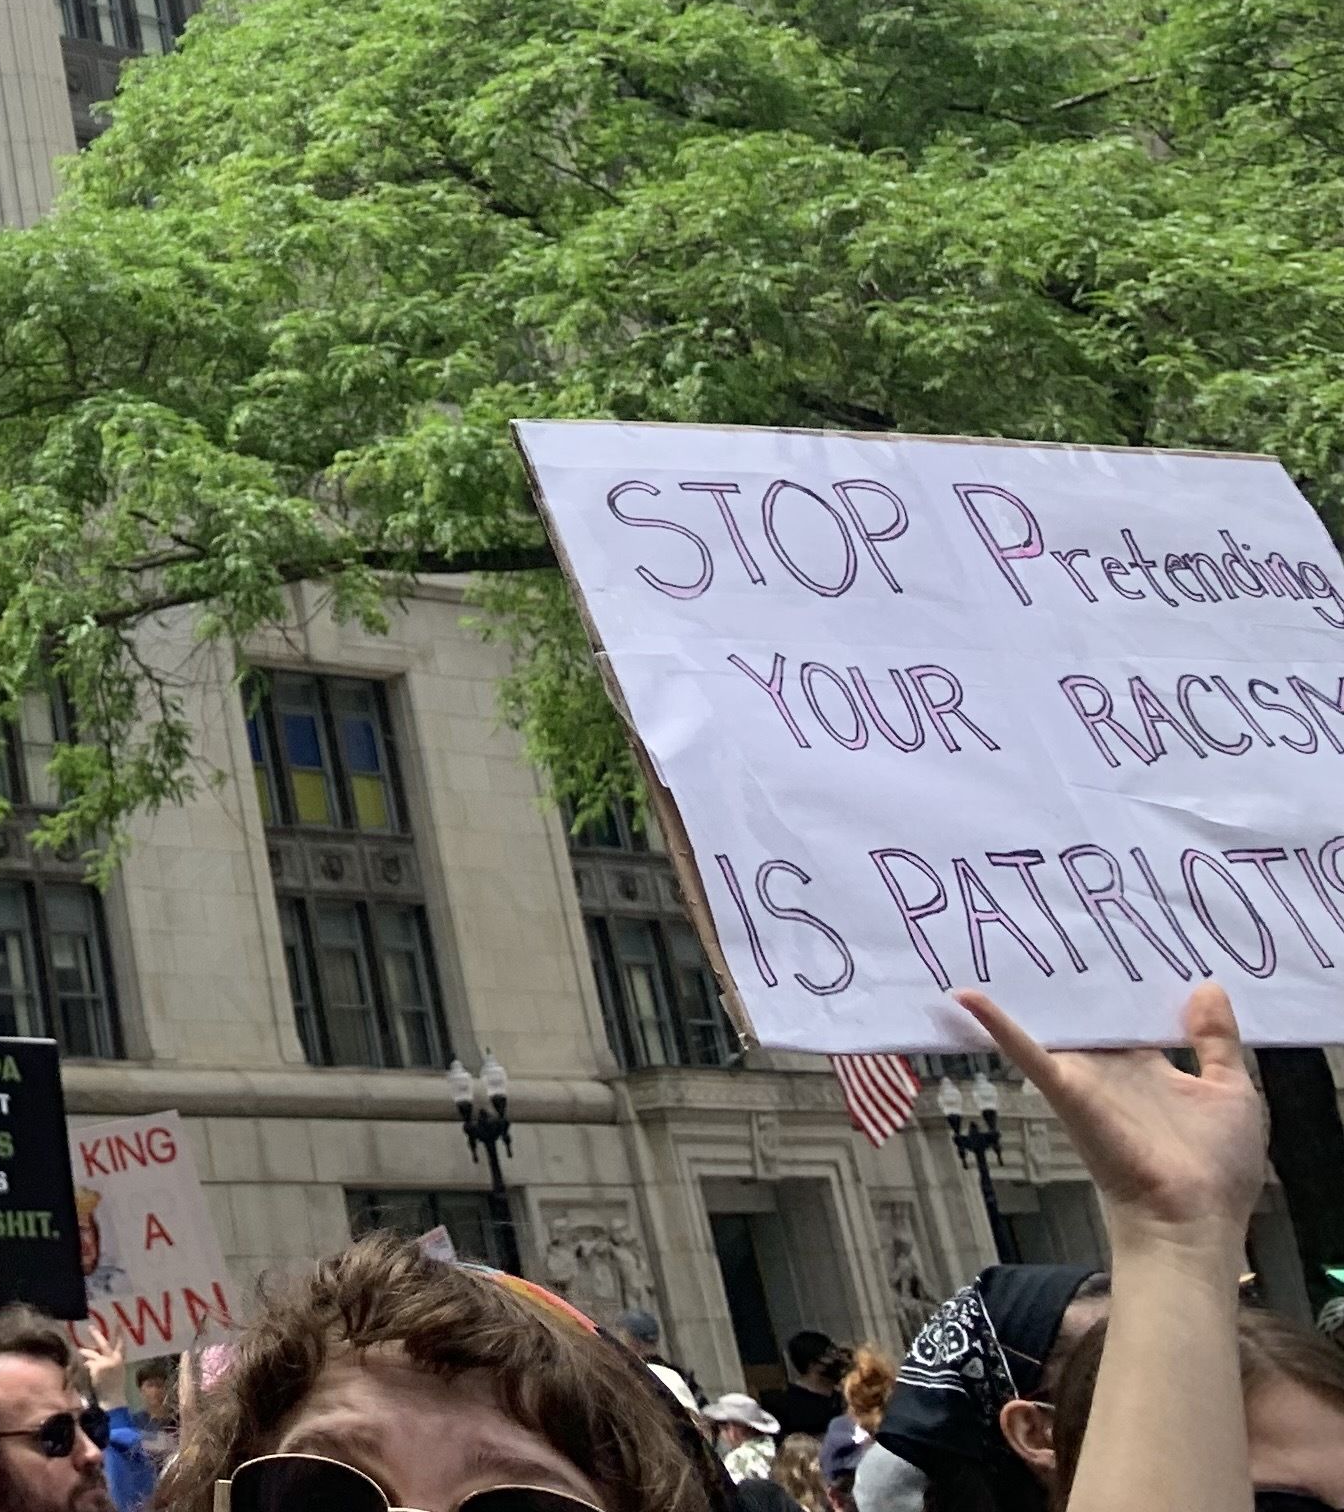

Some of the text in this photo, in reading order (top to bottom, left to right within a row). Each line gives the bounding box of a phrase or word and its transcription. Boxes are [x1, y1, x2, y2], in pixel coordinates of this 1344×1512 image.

[607, 479, 1344, 629] STOP Pretending
[729, 652, 1000, 753] YOUR
[715, 854, 854, 997] IS
[79, 1127, 177, 1177] KING
[145, 1213, 175, 1250] A
